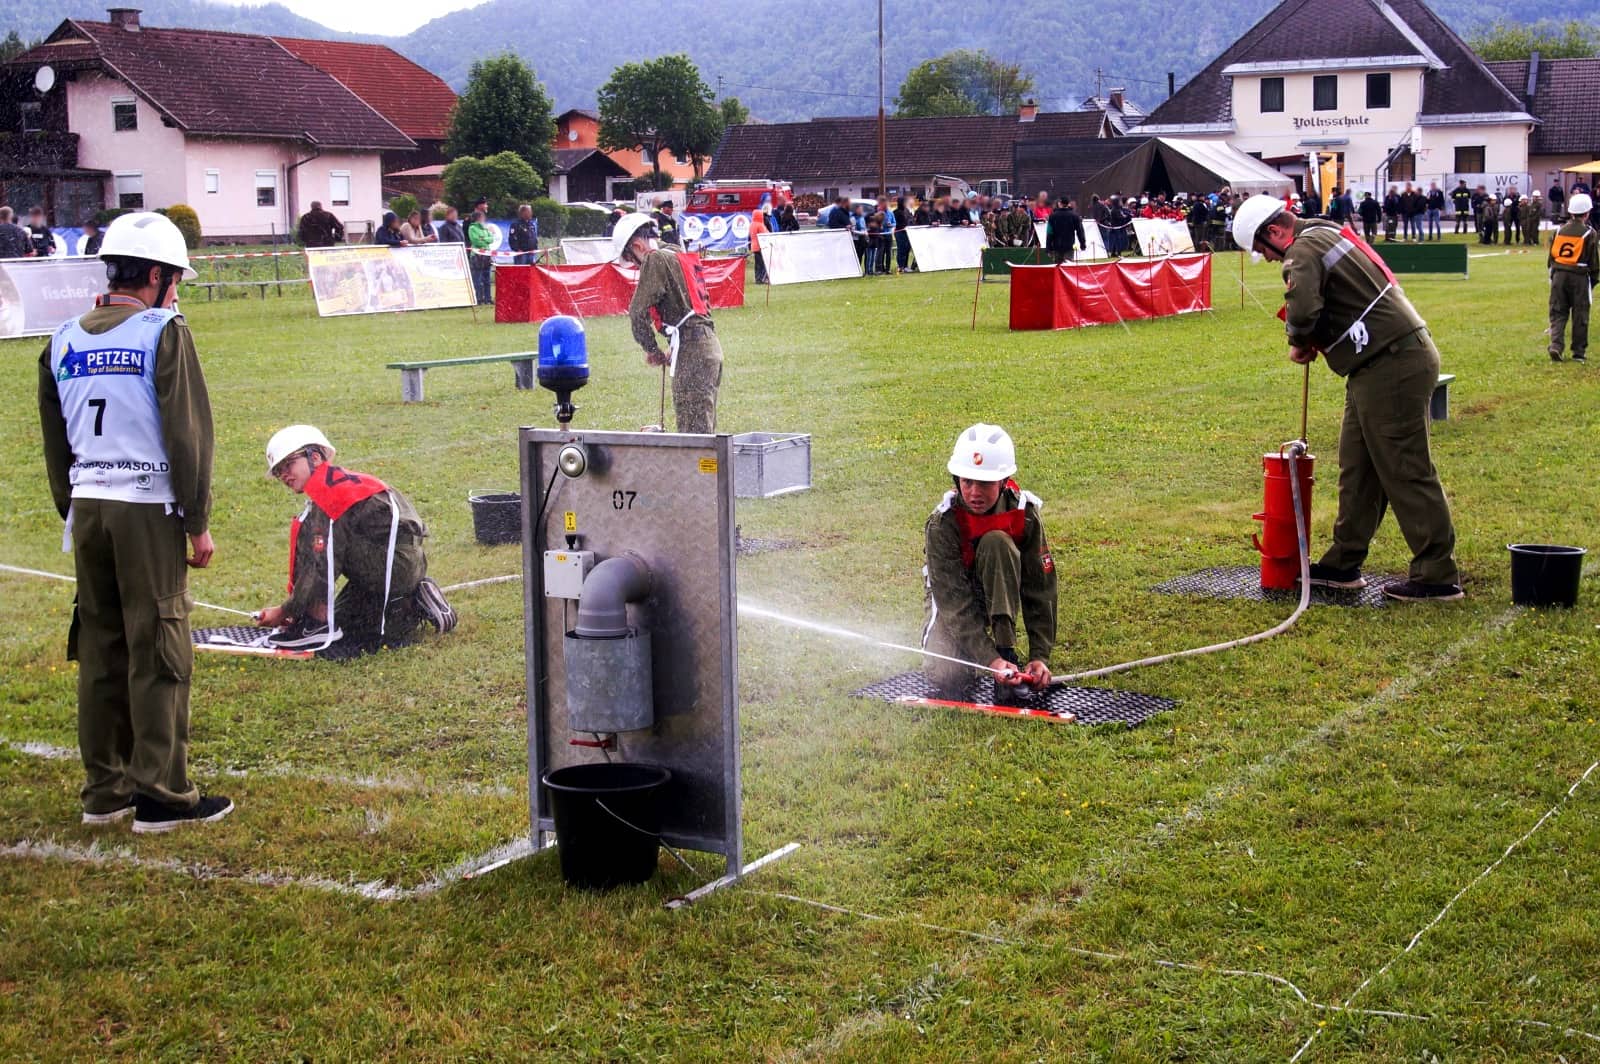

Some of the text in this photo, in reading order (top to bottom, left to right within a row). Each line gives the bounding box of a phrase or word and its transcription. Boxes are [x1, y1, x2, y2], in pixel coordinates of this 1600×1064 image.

[1293, 115, 1370, 130] Volksschule
[1495, 175, 1519, 187] WC
[1559, 242, 1574, 258] 6
[41, 284, 89, 300] fischer
[87, 350, 142, 366] PETZEN
[88, 398, 107, 437] 7
[116, 461, 169, 473] VASOLD
[612, 489, 637, 510] 07
